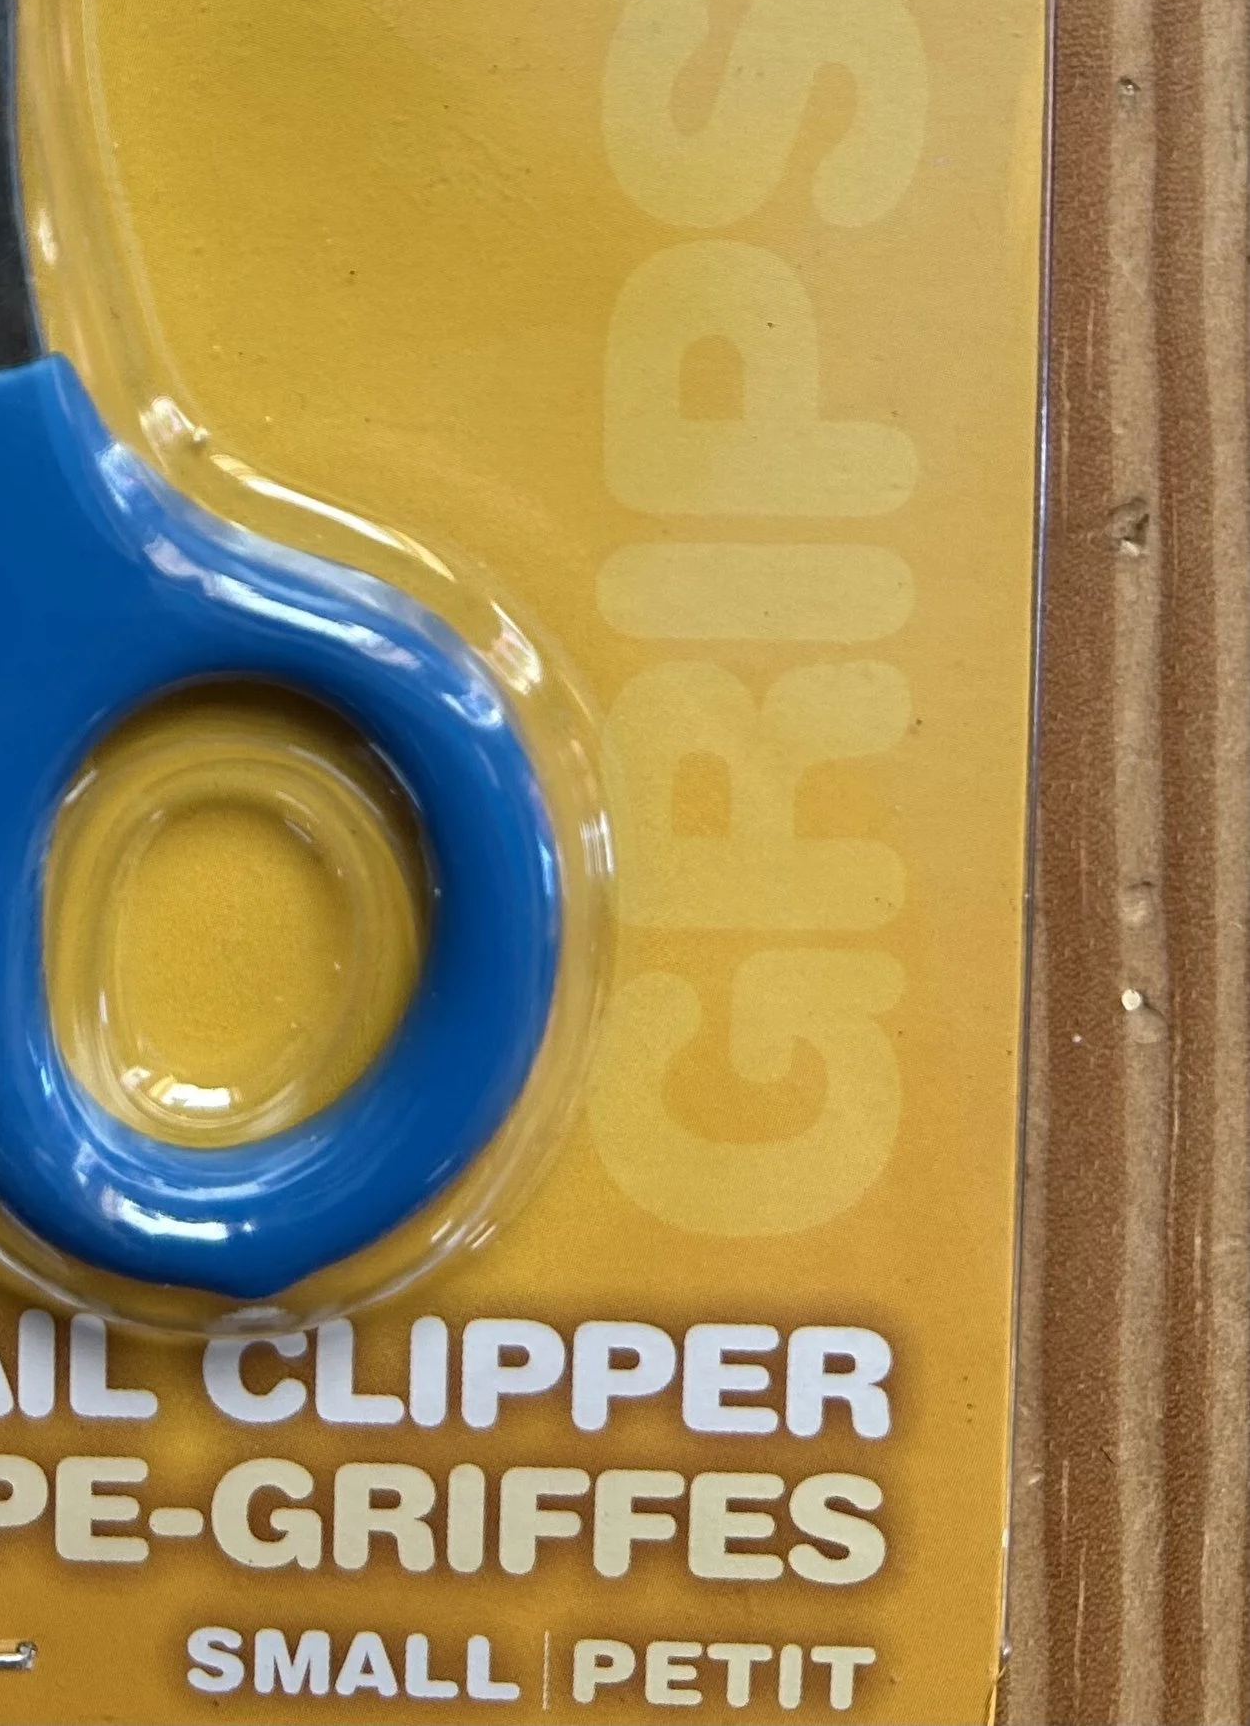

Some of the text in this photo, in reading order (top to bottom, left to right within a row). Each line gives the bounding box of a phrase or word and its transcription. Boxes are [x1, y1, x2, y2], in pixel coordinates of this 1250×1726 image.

[200, 1315, 891, 1439] CLIPPER
[185, 1628, 876, 1710] SMALL PETIT
